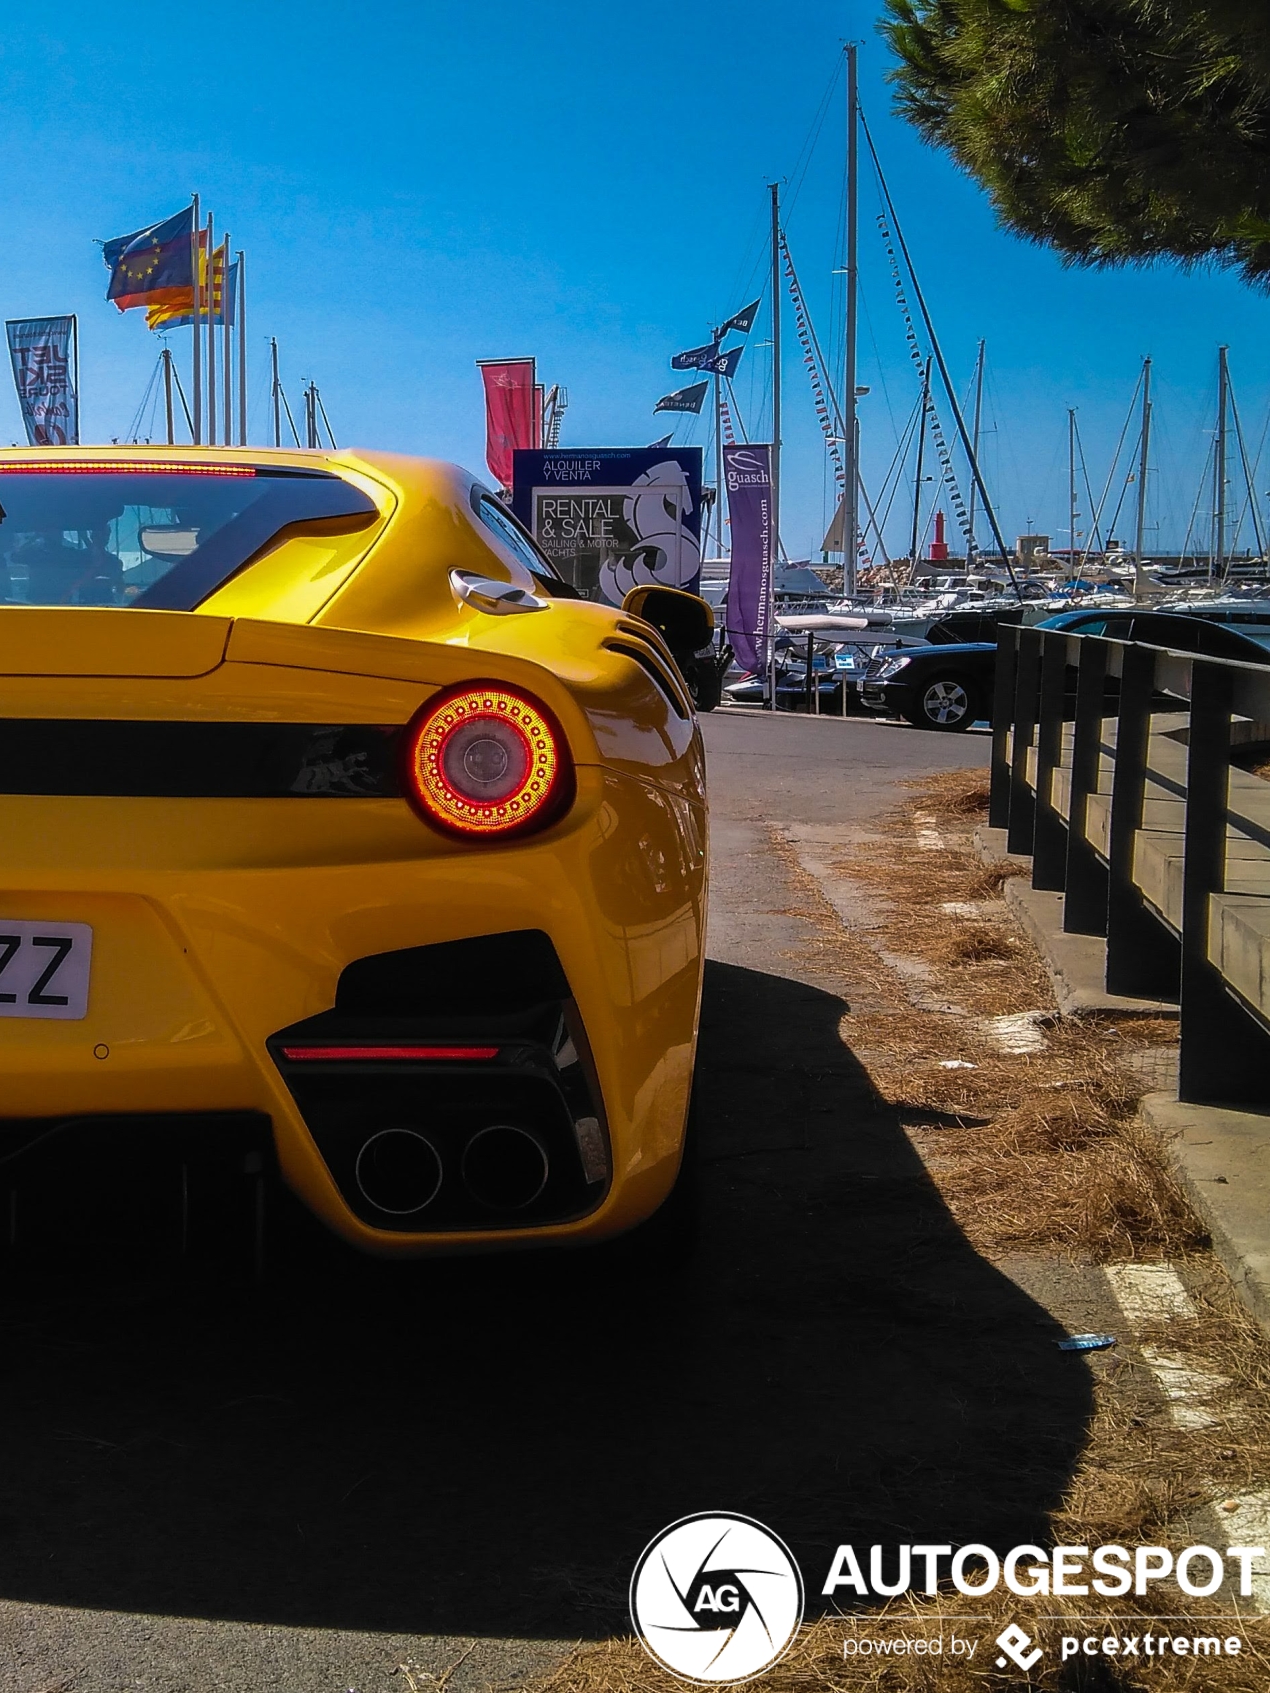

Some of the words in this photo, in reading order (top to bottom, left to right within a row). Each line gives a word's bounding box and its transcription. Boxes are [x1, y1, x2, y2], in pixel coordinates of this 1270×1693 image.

[543, 460, 601, 471] ALQUILER
[543, 471, 551, 481] Y
[554, 471, 592, 481] VENTA
[728, 469, 769, 491] guasch
[542, 499, 619, 519] RENTAL
[541, 519, 557, 538] &
[561, 519, 614, 538] SALE
[541, 539, 577, 549] SAILING
[579, 540, 586, 549] &
[587, 539, 619, 549] MOTOR
